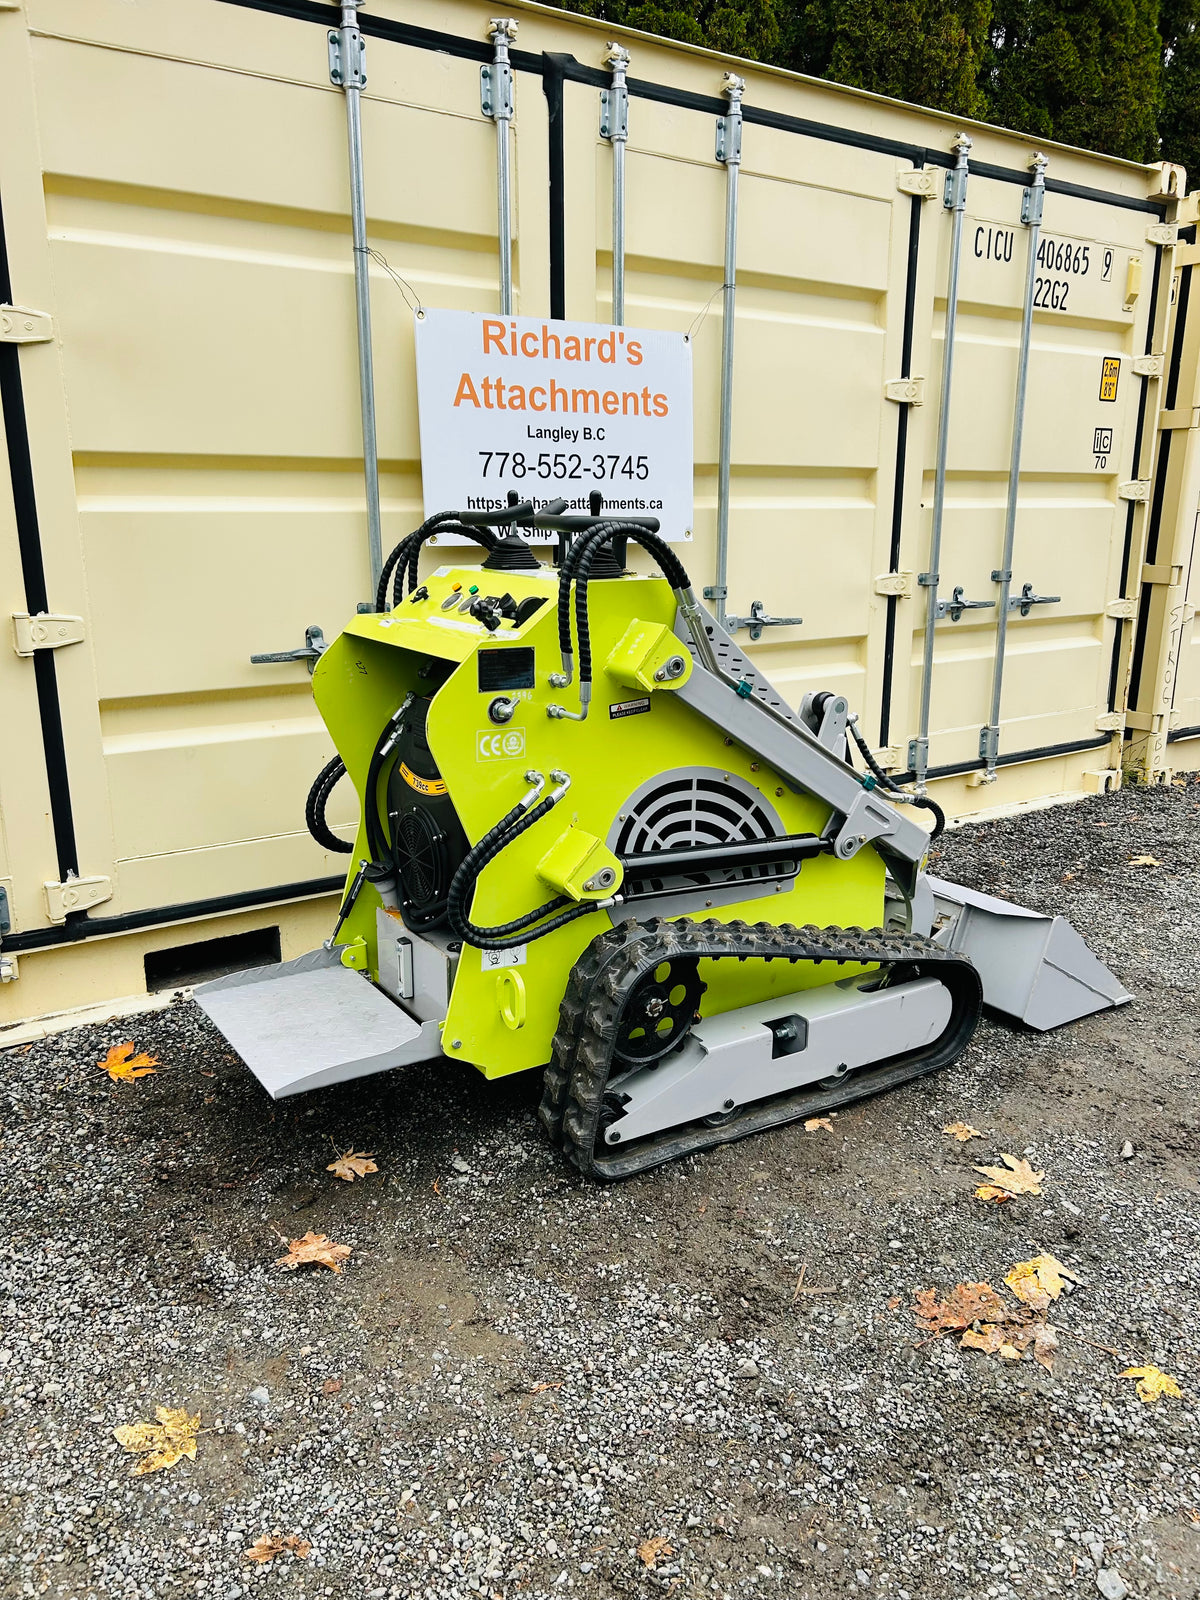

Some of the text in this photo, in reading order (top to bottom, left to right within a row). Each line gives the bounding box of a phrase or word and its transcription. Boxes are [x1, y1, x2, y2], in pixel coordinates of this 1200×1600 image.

[974, 226, 1113, 279] CICU 406865 9
[1033, 277, 1070, 311] 22G2
[482, 319, 644, 366] Richard's
[453, 372, 669, 418] Attachments
[527, 425, 606, 443] Langley B.C
[478, 451, 650, 481] 778-552-3745
[1094, 455, 1107, 469] 70
[497, 526, 520, 538] W
[523, 526, 552, 540] Ship
